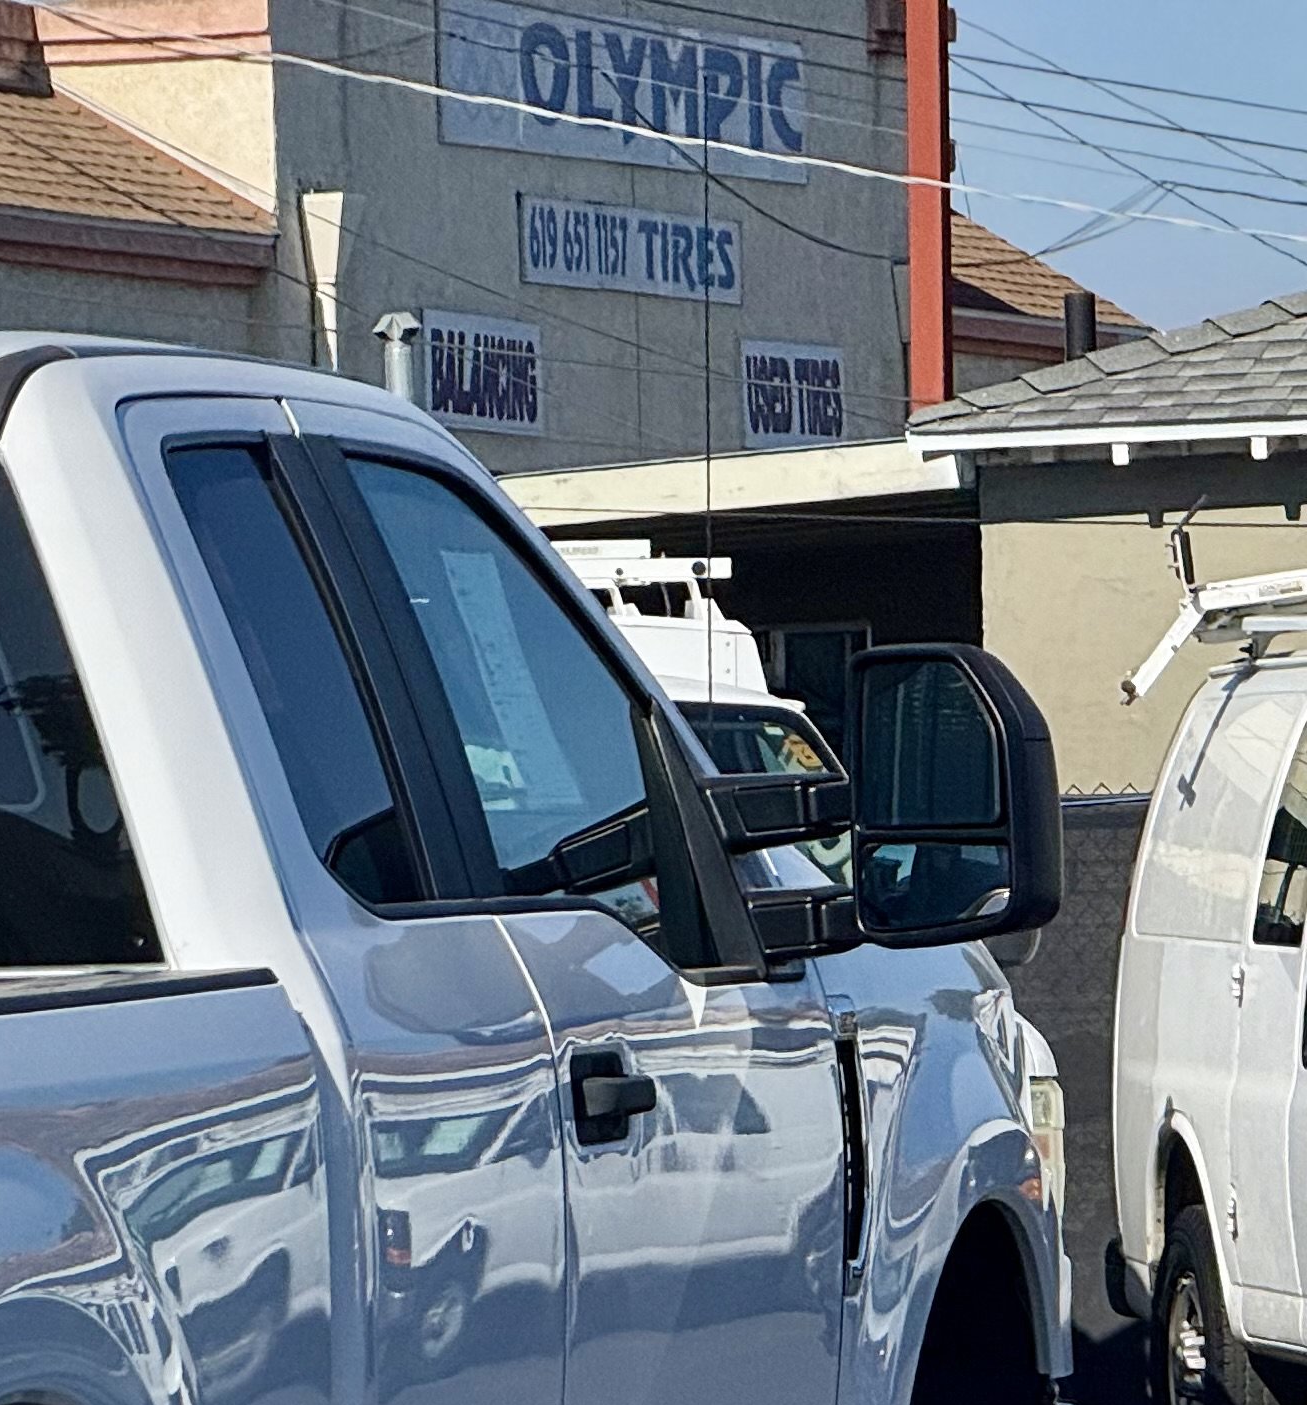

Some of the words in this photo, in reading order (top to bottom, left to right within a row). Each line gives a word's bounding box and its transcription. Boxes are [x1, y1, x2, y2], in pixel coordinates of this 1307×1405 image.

[520, 22, 803, 152] OLYMPIC
[530, 205, 557, 270] 619
[563, 208, 590, 274] 651
[638, 218, 735, 292] TIRES
[430, 327, 537, 423] BALANCING
[745, 354, 792, 434] USED
[794, 357, 842, 438] TIRES
